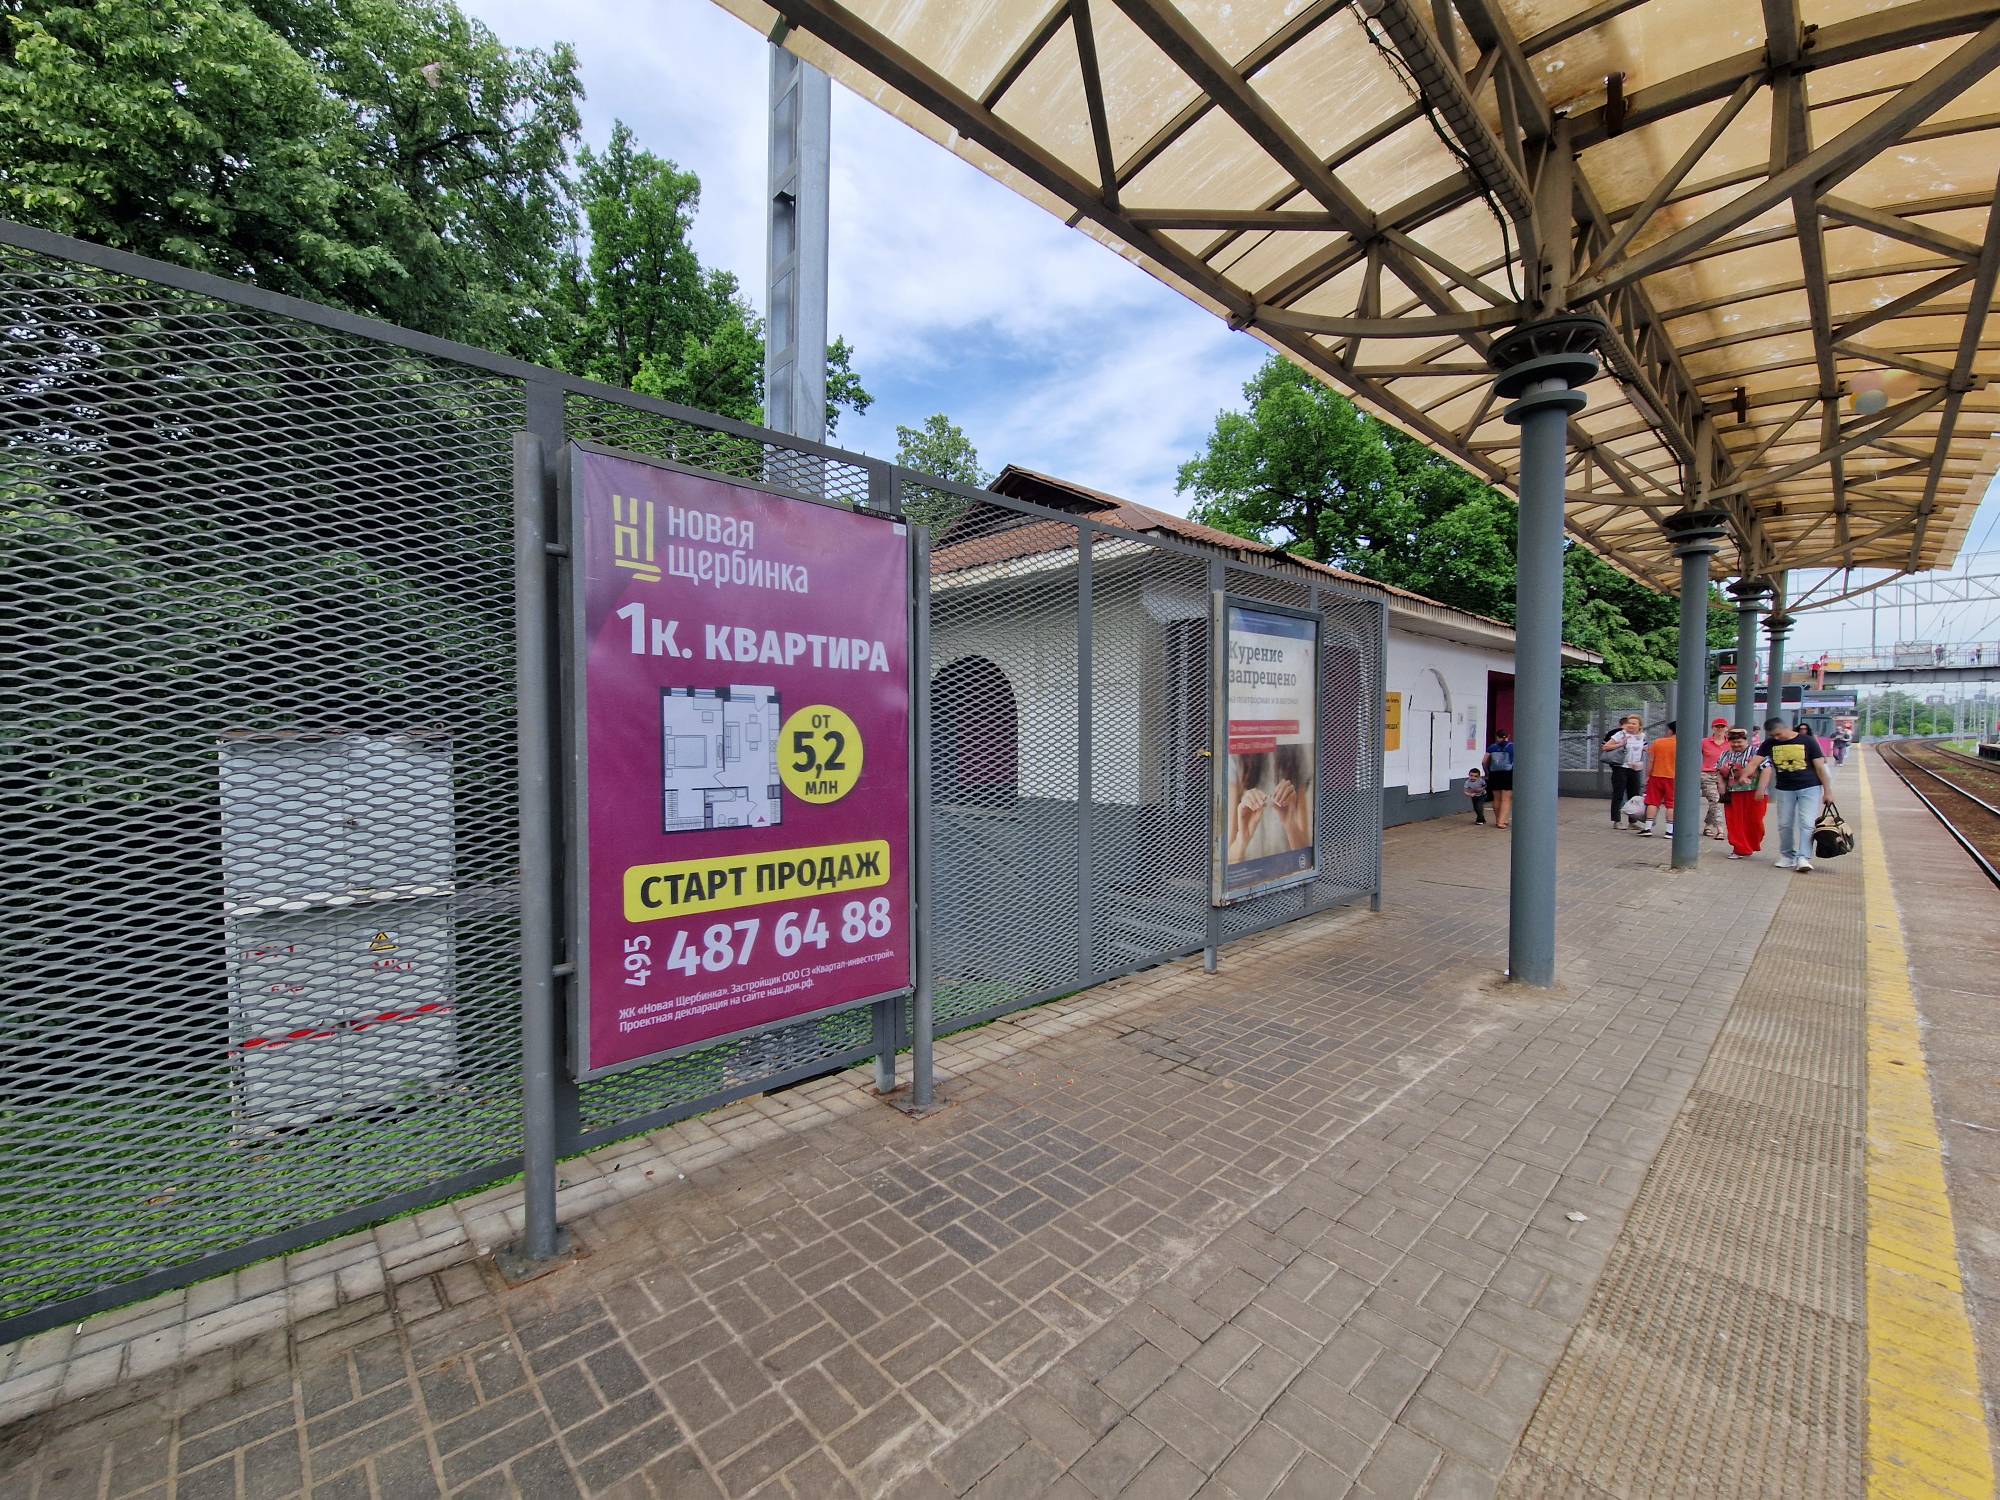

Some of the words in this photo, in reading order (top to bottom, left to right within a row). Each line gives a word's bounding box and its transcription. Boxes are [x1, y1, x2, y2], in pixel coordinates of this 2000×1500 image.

[705, 623, 890, 673] КВАРТИРА
[1229, 641, 1284, 664] Курение
[1229, 669, 1297, 689] запрещено
[792, 730, 846, 778] 5,2
[804, 780, 839, 796] МЛН
[640, 866, 748, 909] СТАРТ
[756, 850, 882, 893] ПРОДАЖ
[624, 935, 652, 987] 495
[666, 919, 761, 977] 487
[774, 908, 830, 957] 64
[841, 897, 892, 943] 88
[619, 1008, 636, 1020] ЖК
[638, 1000, 674, 1015] «Новая
[730, 975, 782, 994] Застройщик
[782, 970, 800, 982] ООО
[619, 1012, 674, 1033] Проектная
[674, 1000, 729, 1021] декларация
[729, 998, 741, 1006] на
[741, 989, 766, 1003] сайте
